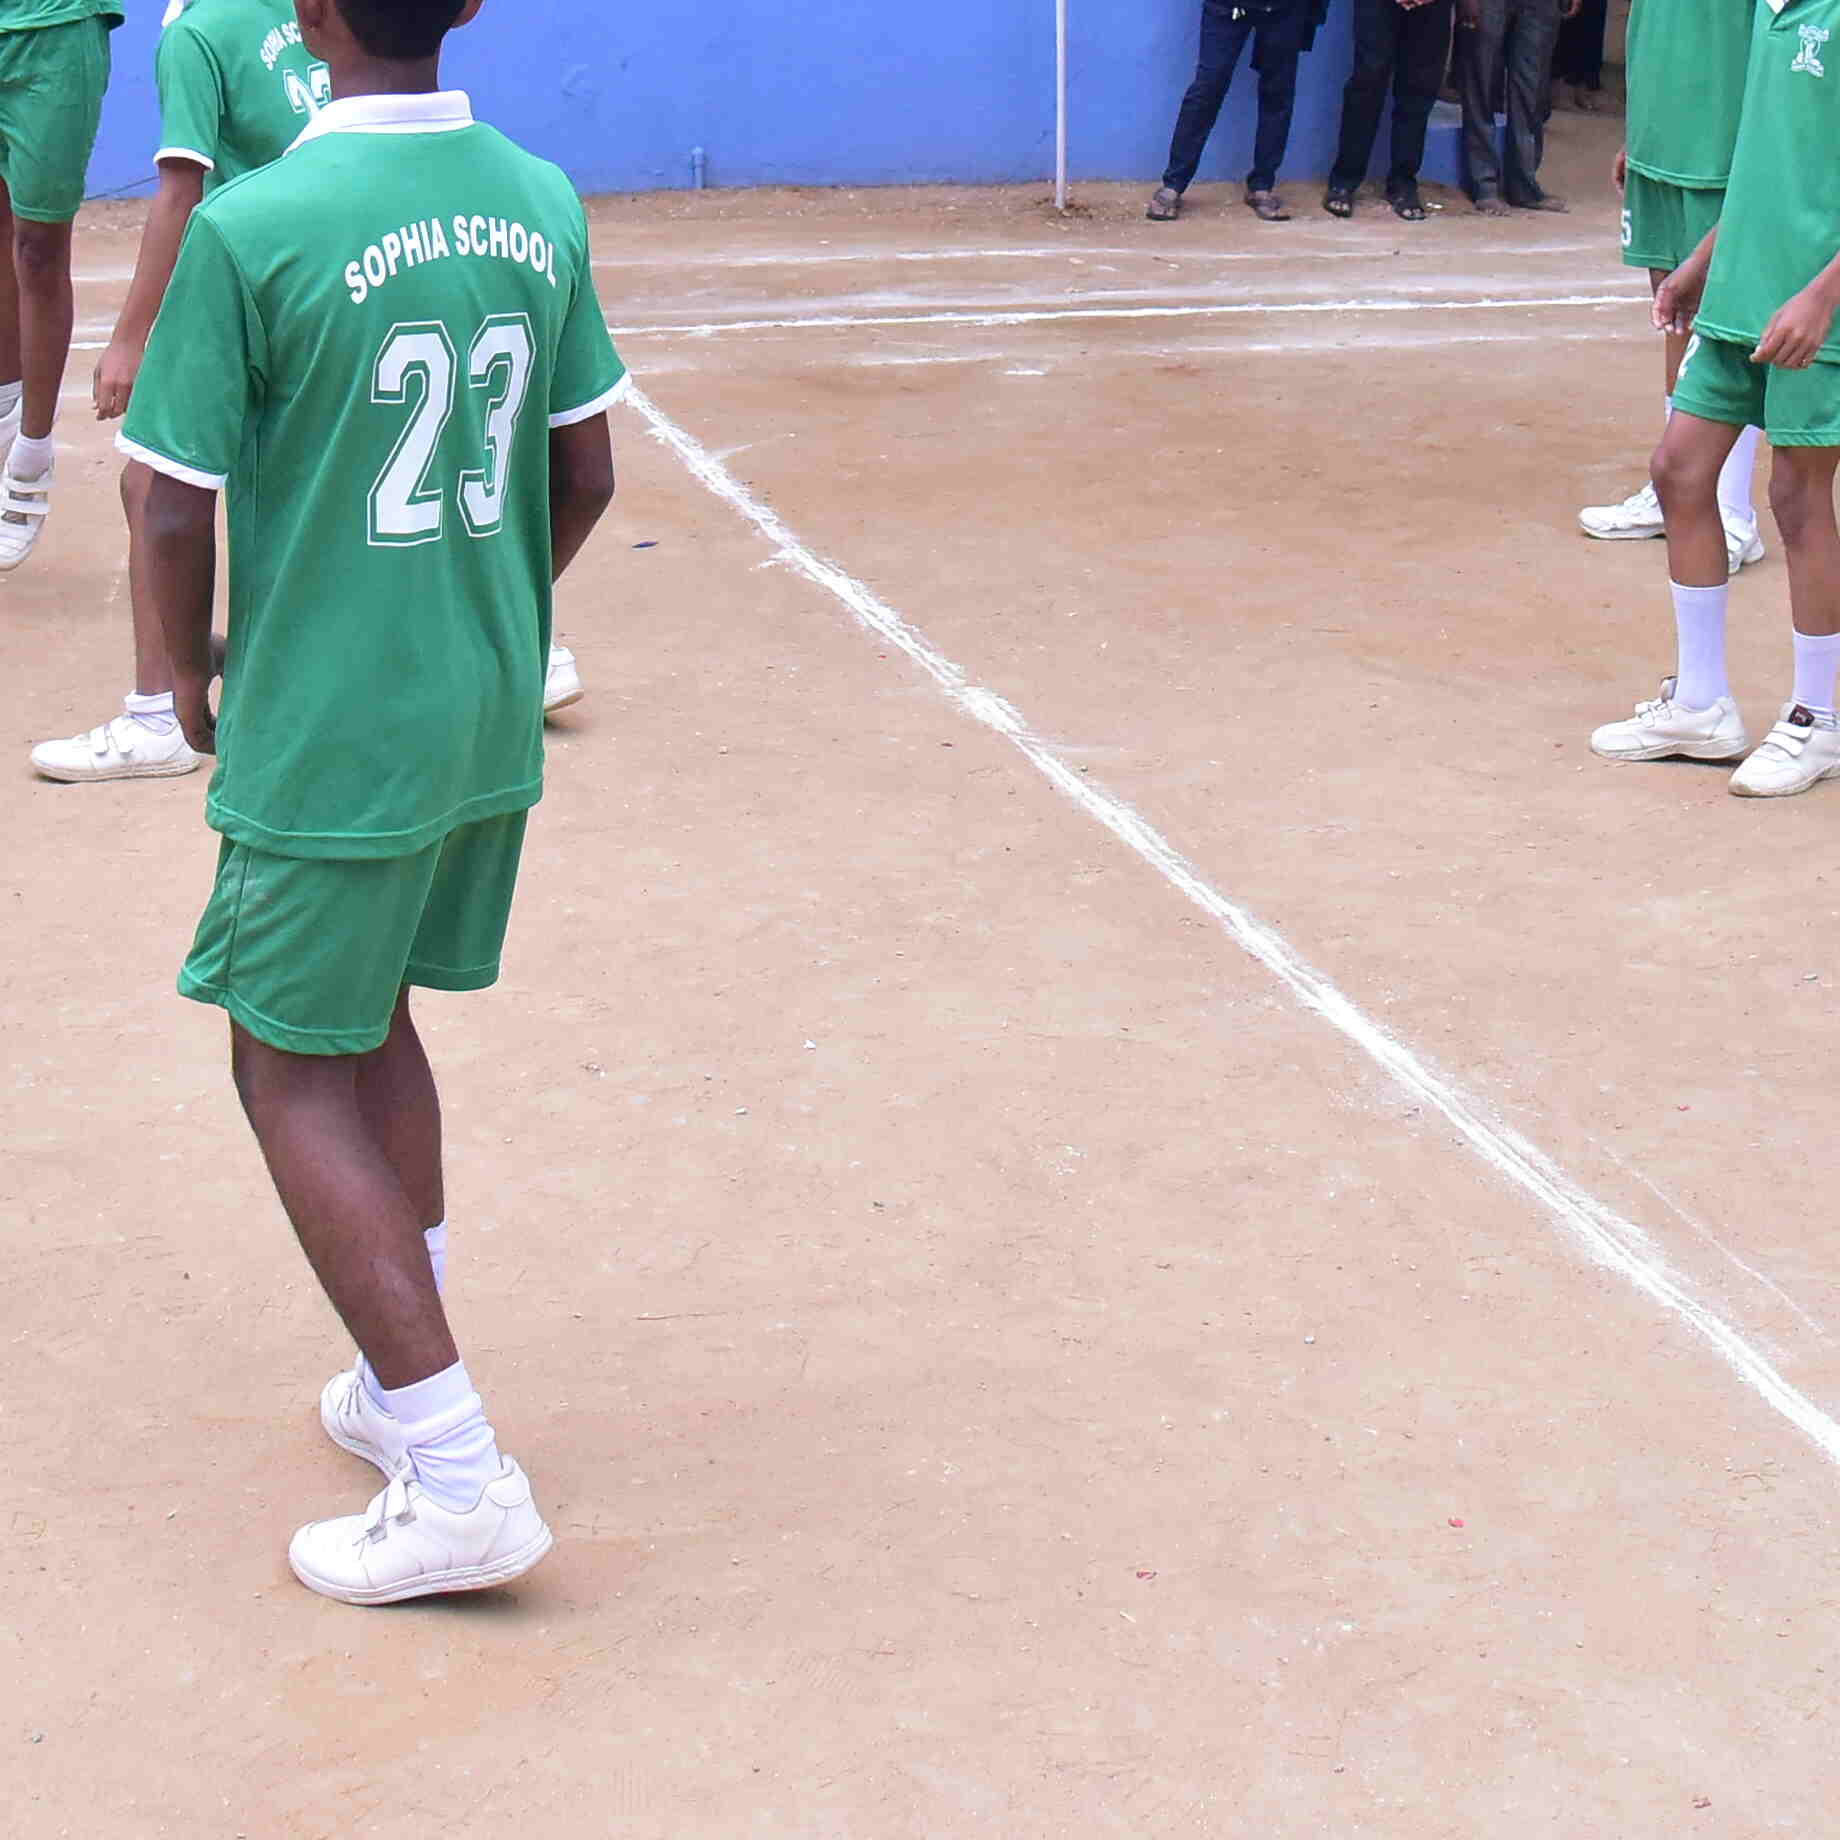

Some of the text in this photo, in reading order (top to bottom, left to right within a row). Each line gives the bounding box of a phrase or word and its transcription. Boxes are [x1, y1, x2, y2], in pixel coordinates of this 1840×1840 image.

[344, 214, 556, 304] SOPHIA SCHOOL
[367, 312, 536, 546] 23
